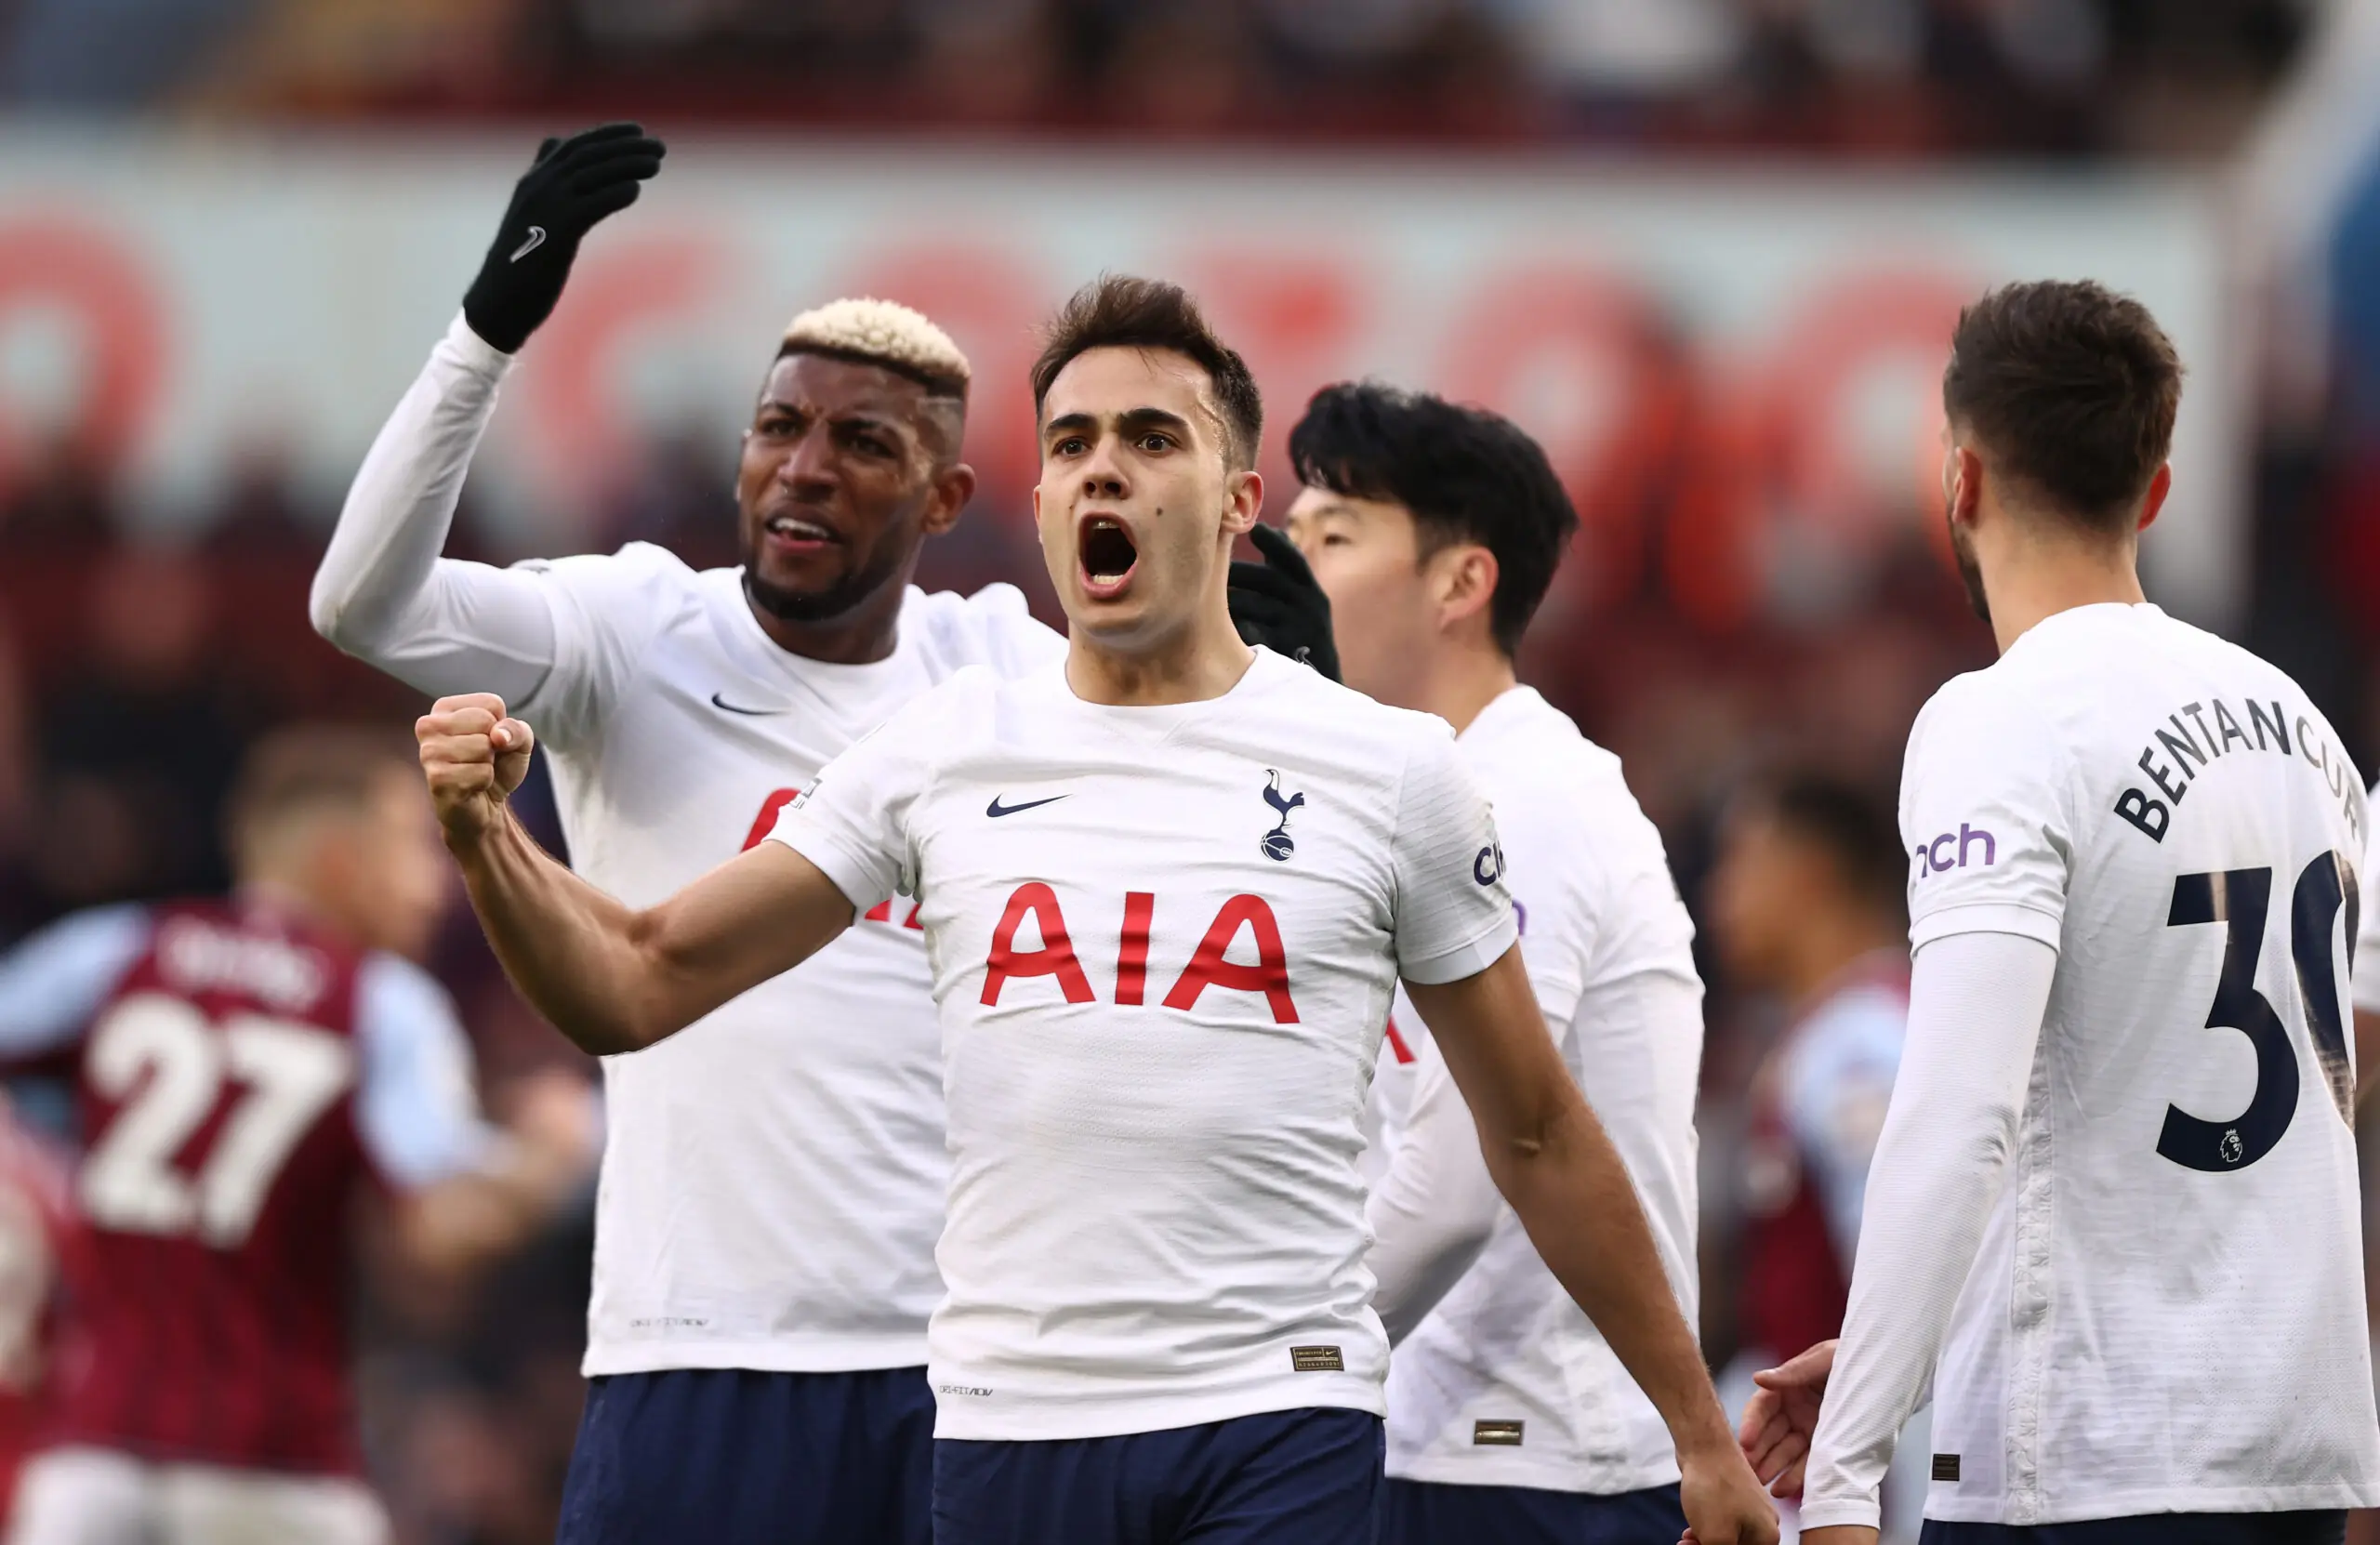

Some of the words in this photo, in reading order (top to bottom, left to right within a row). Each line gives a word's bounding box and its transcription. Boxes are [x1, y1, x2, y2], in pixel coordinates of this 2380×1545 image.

[980, 881, 1301, 1023] AIA
[2156, 849, 2360, 1172] 30
[84, 991, 353, 1249] 27
